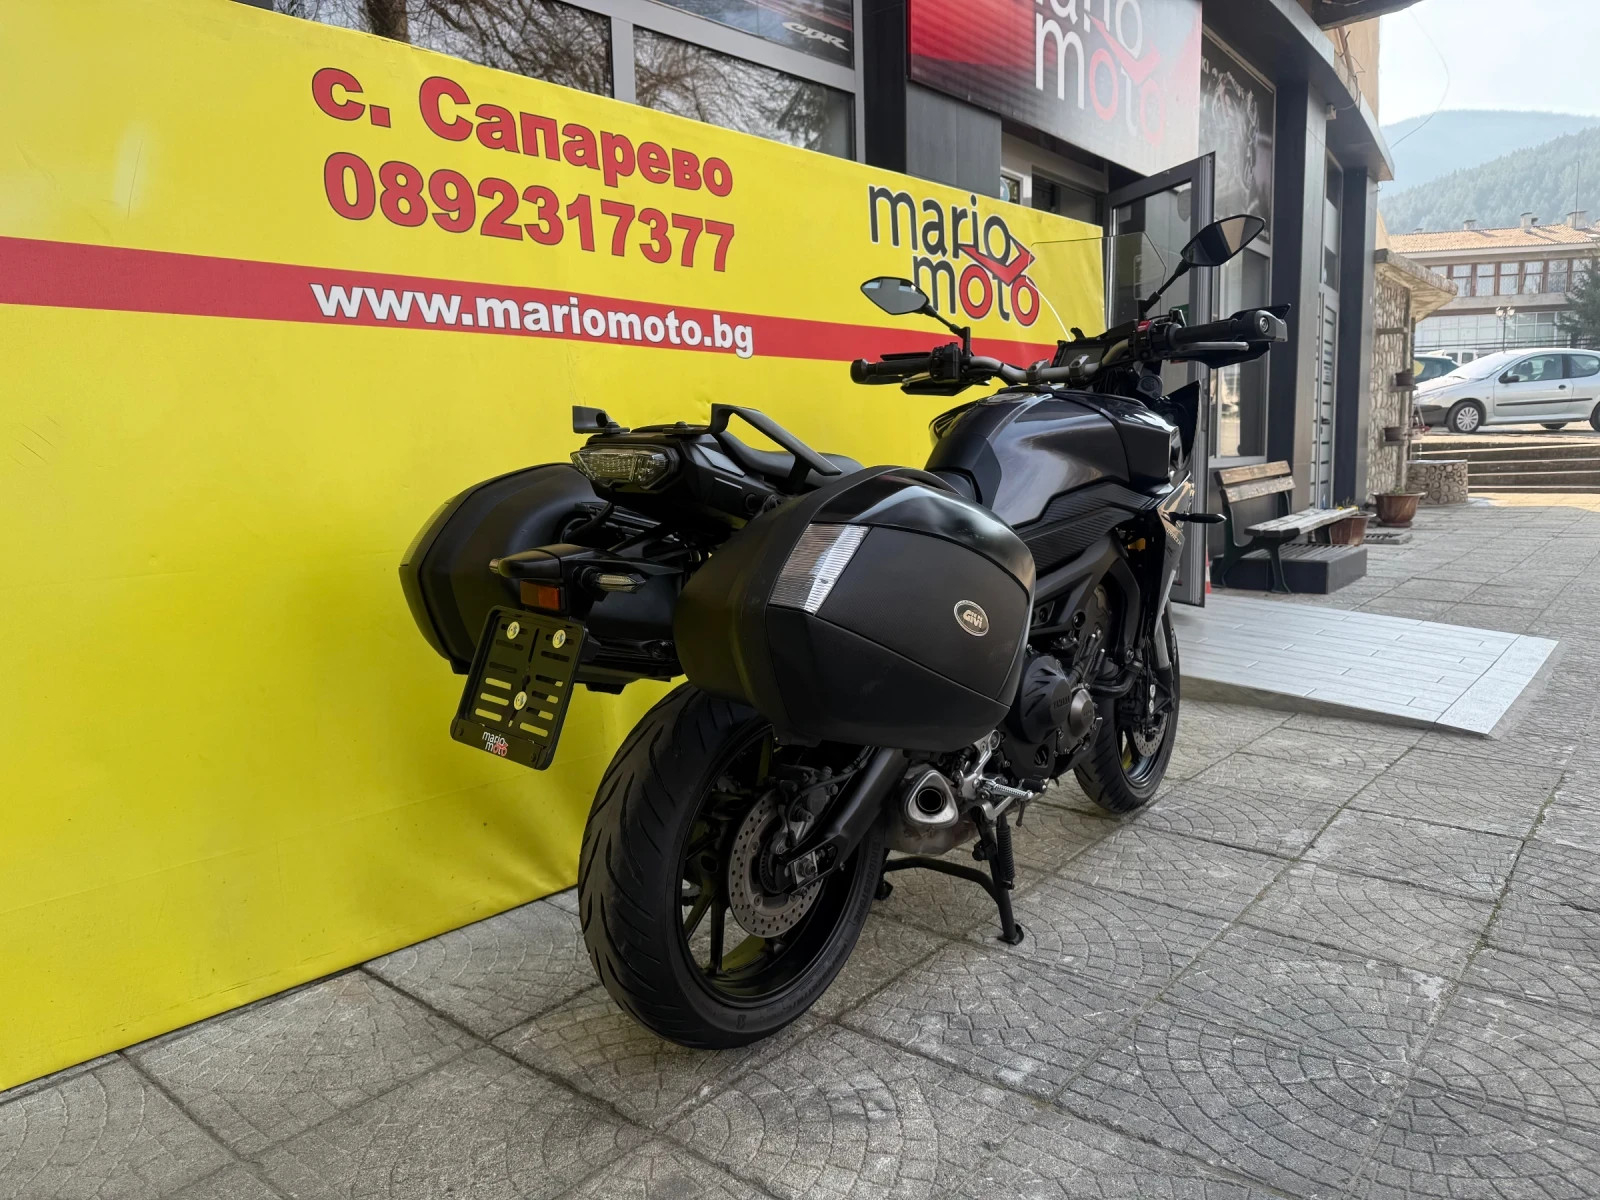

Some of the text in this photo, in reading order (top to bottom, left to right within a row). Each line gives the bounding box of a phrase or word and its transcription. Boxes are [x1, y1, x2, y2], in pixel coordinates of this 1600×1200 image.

[781, 21, 850, 51] CBR
[1035, 12, 1166, 146] moto
[311, 67, 734, 197] с. Сапарево
[323, 151, 735, 272] 0892317377
[868, 184, 1011, 266] mario
[309, 282, 754, 359] www.mariomoto.bg
[912, 254, 1041, 327] moto
[481, 731, 506, 745] mario
[484, 741, 508, 757] moto
